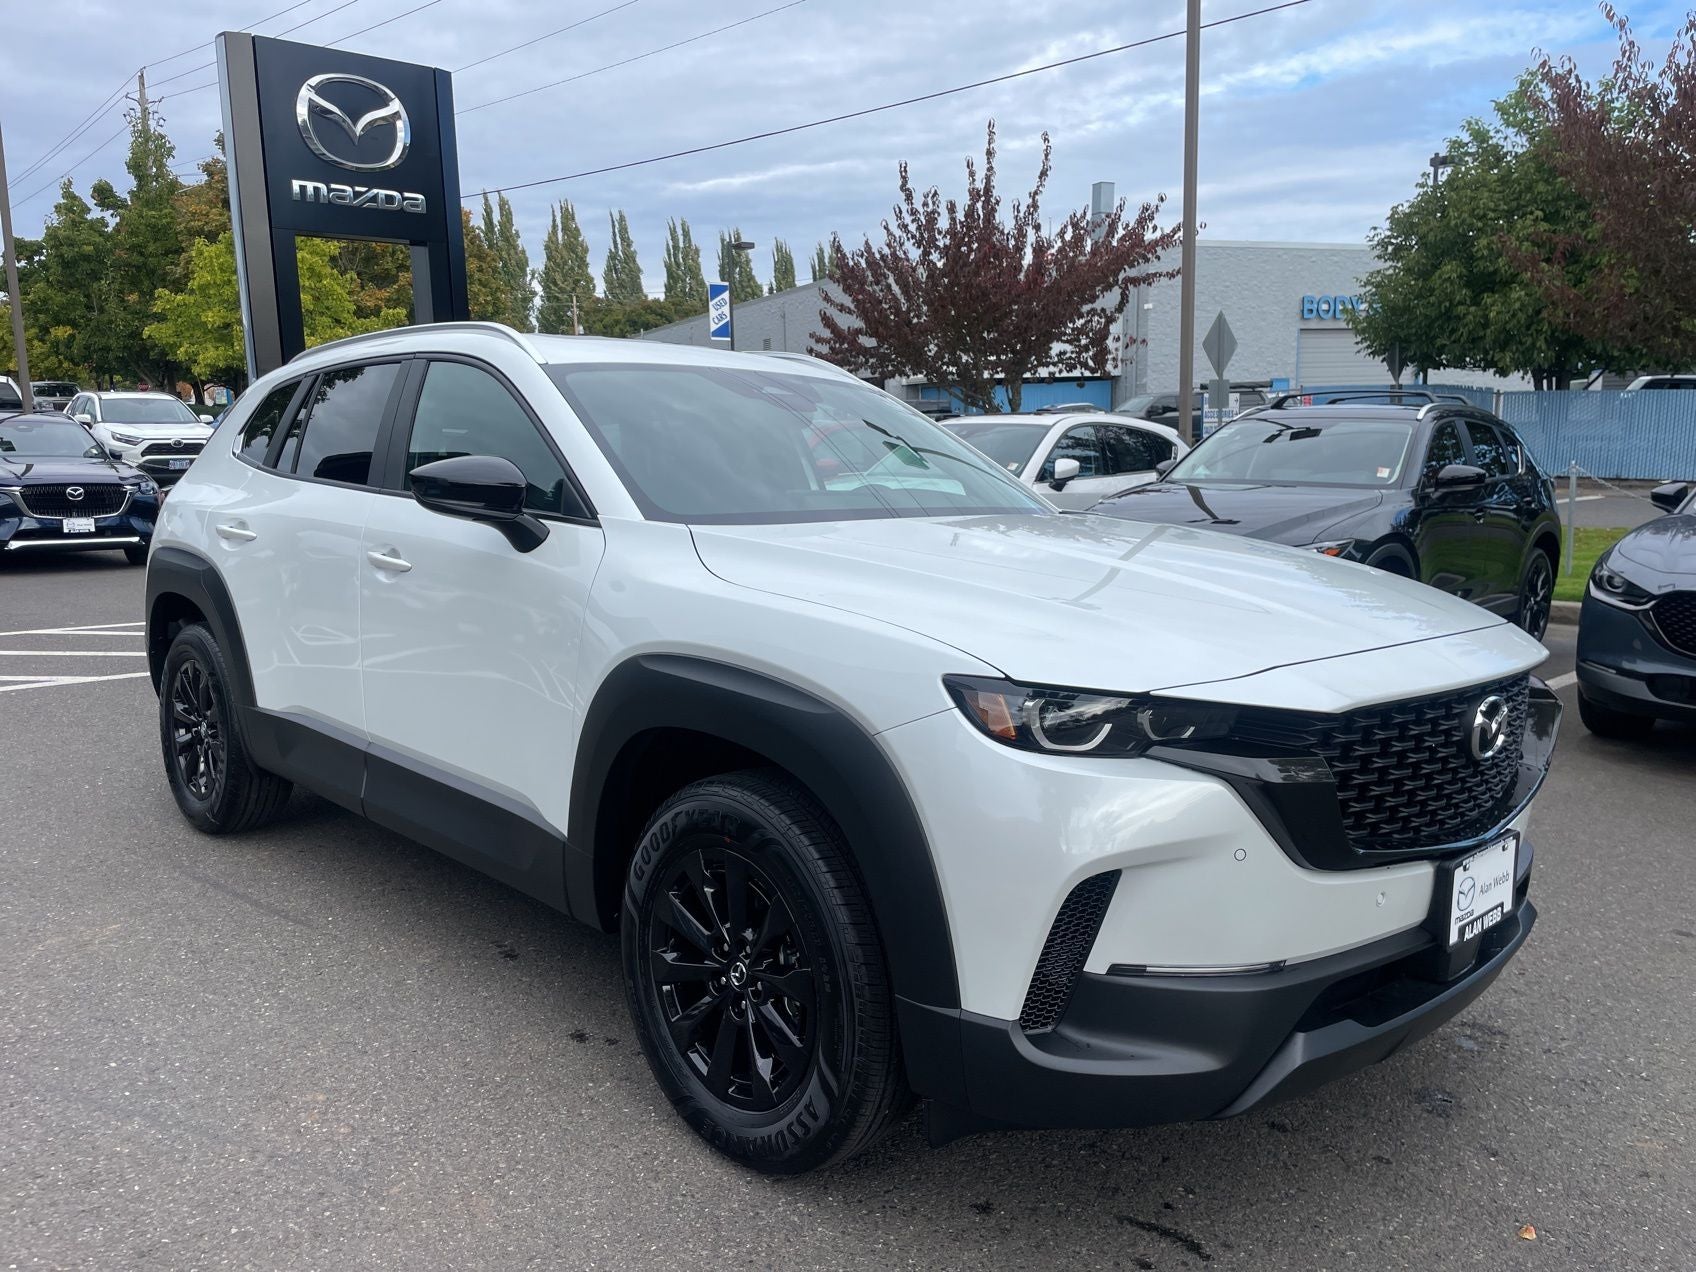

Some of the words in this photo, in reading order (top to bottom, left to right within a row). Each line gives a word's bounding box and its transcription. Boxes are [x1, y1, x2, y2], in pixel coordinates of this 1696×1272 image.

[712, 297, 727, 311] USED
[712, 311, 728, 325] CARS
[1479, 882, 1493, 897] Alan
[1494, 871, 1510, 889] Webb
[1455, 908, 1475, 925] mazda
[1464, 918, 1483, 941] ALAN
[1483, 906, 1502, 930] WEBB
